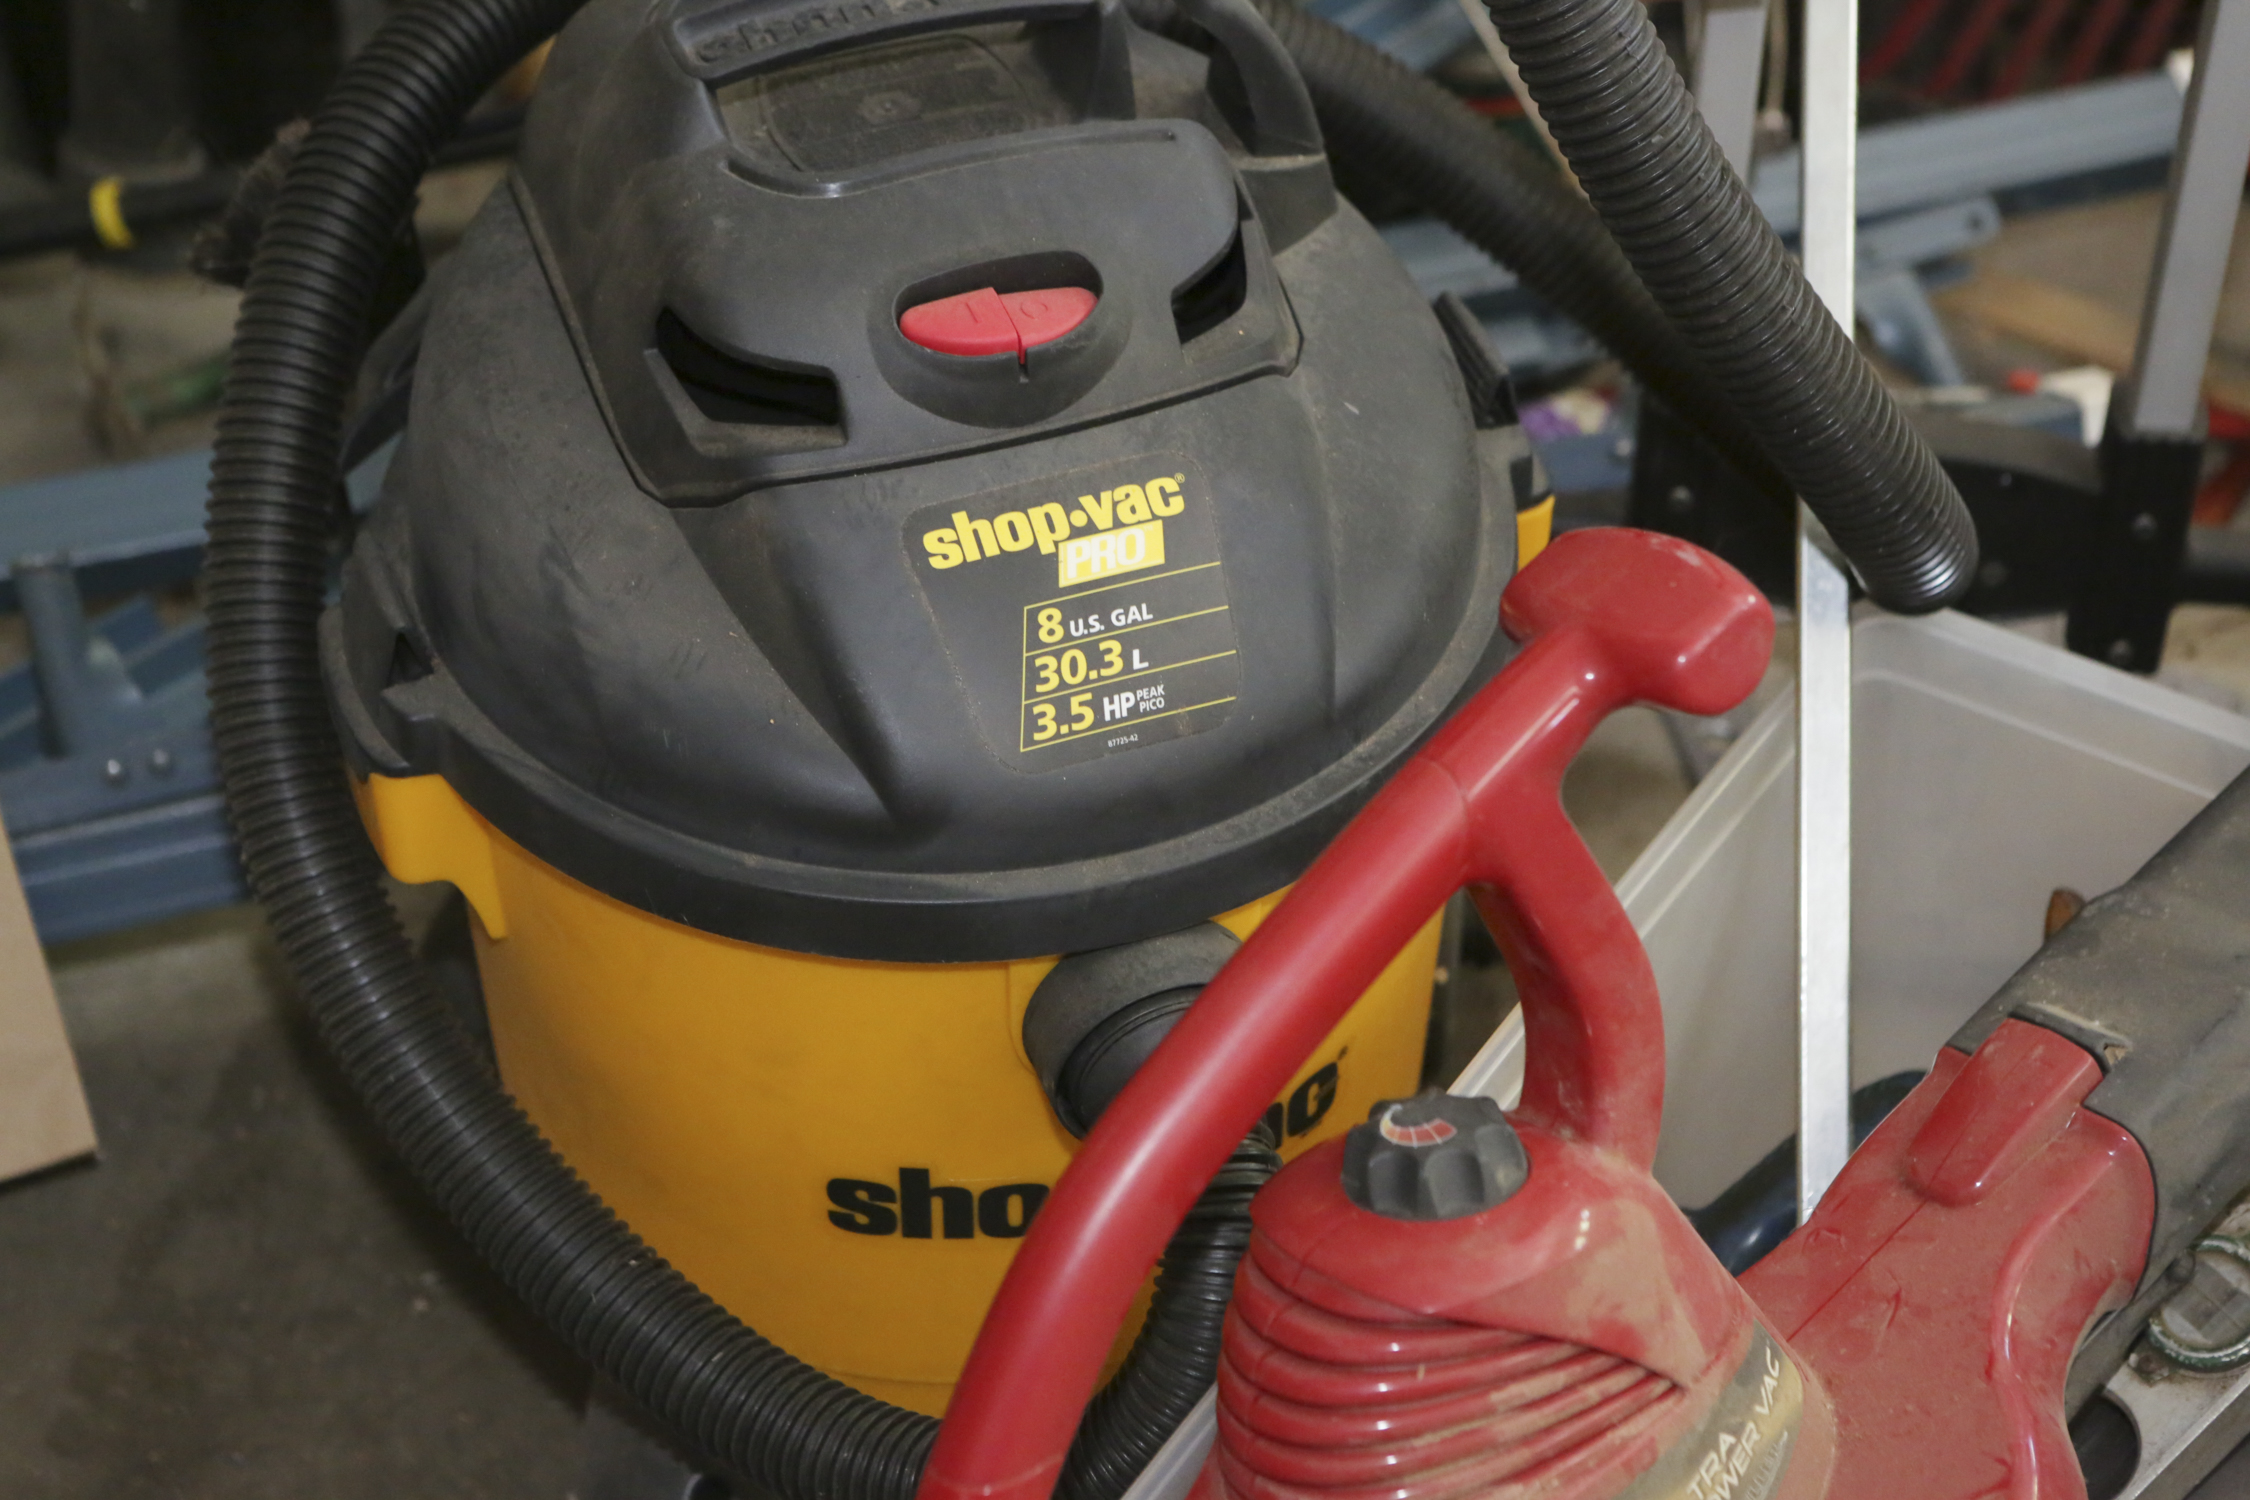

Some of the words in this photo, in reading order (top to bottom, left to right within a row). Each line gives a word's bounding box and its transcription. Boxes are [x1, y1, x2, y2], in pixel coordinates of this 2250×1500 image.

[1037, 607, 1064, 644] 8
[1069, 613, 1105, 637] U.S.
[1110, 602, 1154, 627] GAL
[1034, 639, 1124, 693] 30.3
[1132, 648, 1149, 670] L
[1136, 683, 1165, 701] PEAK
[1032, 692, 1095, 741] 3.5
[1103, 691, 1136, 722] HP
[1139, 696, 1165, 713] PICO
[826, 1167, 1050, 1240] sho
[1754, 1344, 1780, 1416] VAC
[1685, 1431, 1738, 1500] TRA
